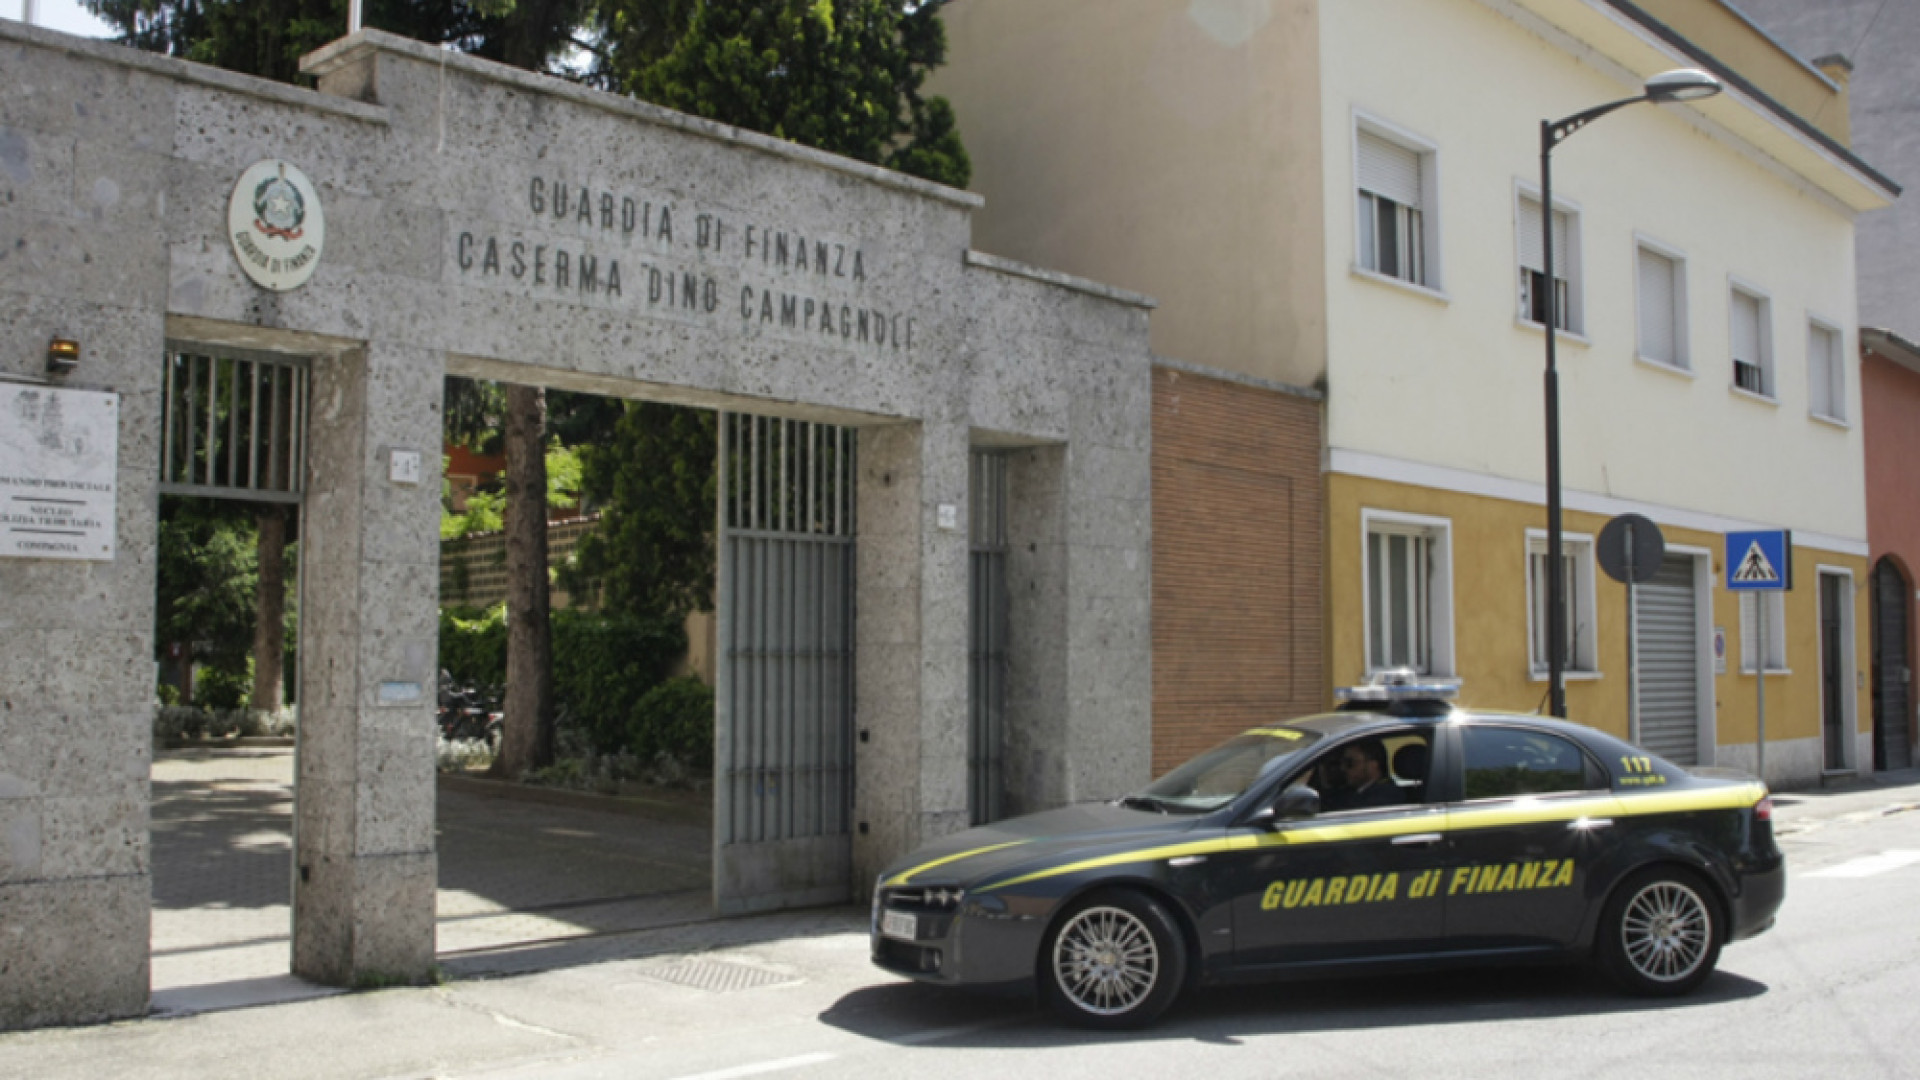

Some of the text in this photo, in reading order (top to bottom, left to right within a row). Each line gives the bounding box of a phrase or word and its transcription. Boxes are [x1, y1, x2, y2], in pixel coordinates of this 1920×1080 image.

[529, 175, 866, 284] GUARDIA DI FINANZA
[458, 230, 918, 351] CASERMA DINO CAMPAGNOLE
[1620, 755, 1652, 773] 117
[1260, 858, 1575, 911] GUARDIA di FINANZA
